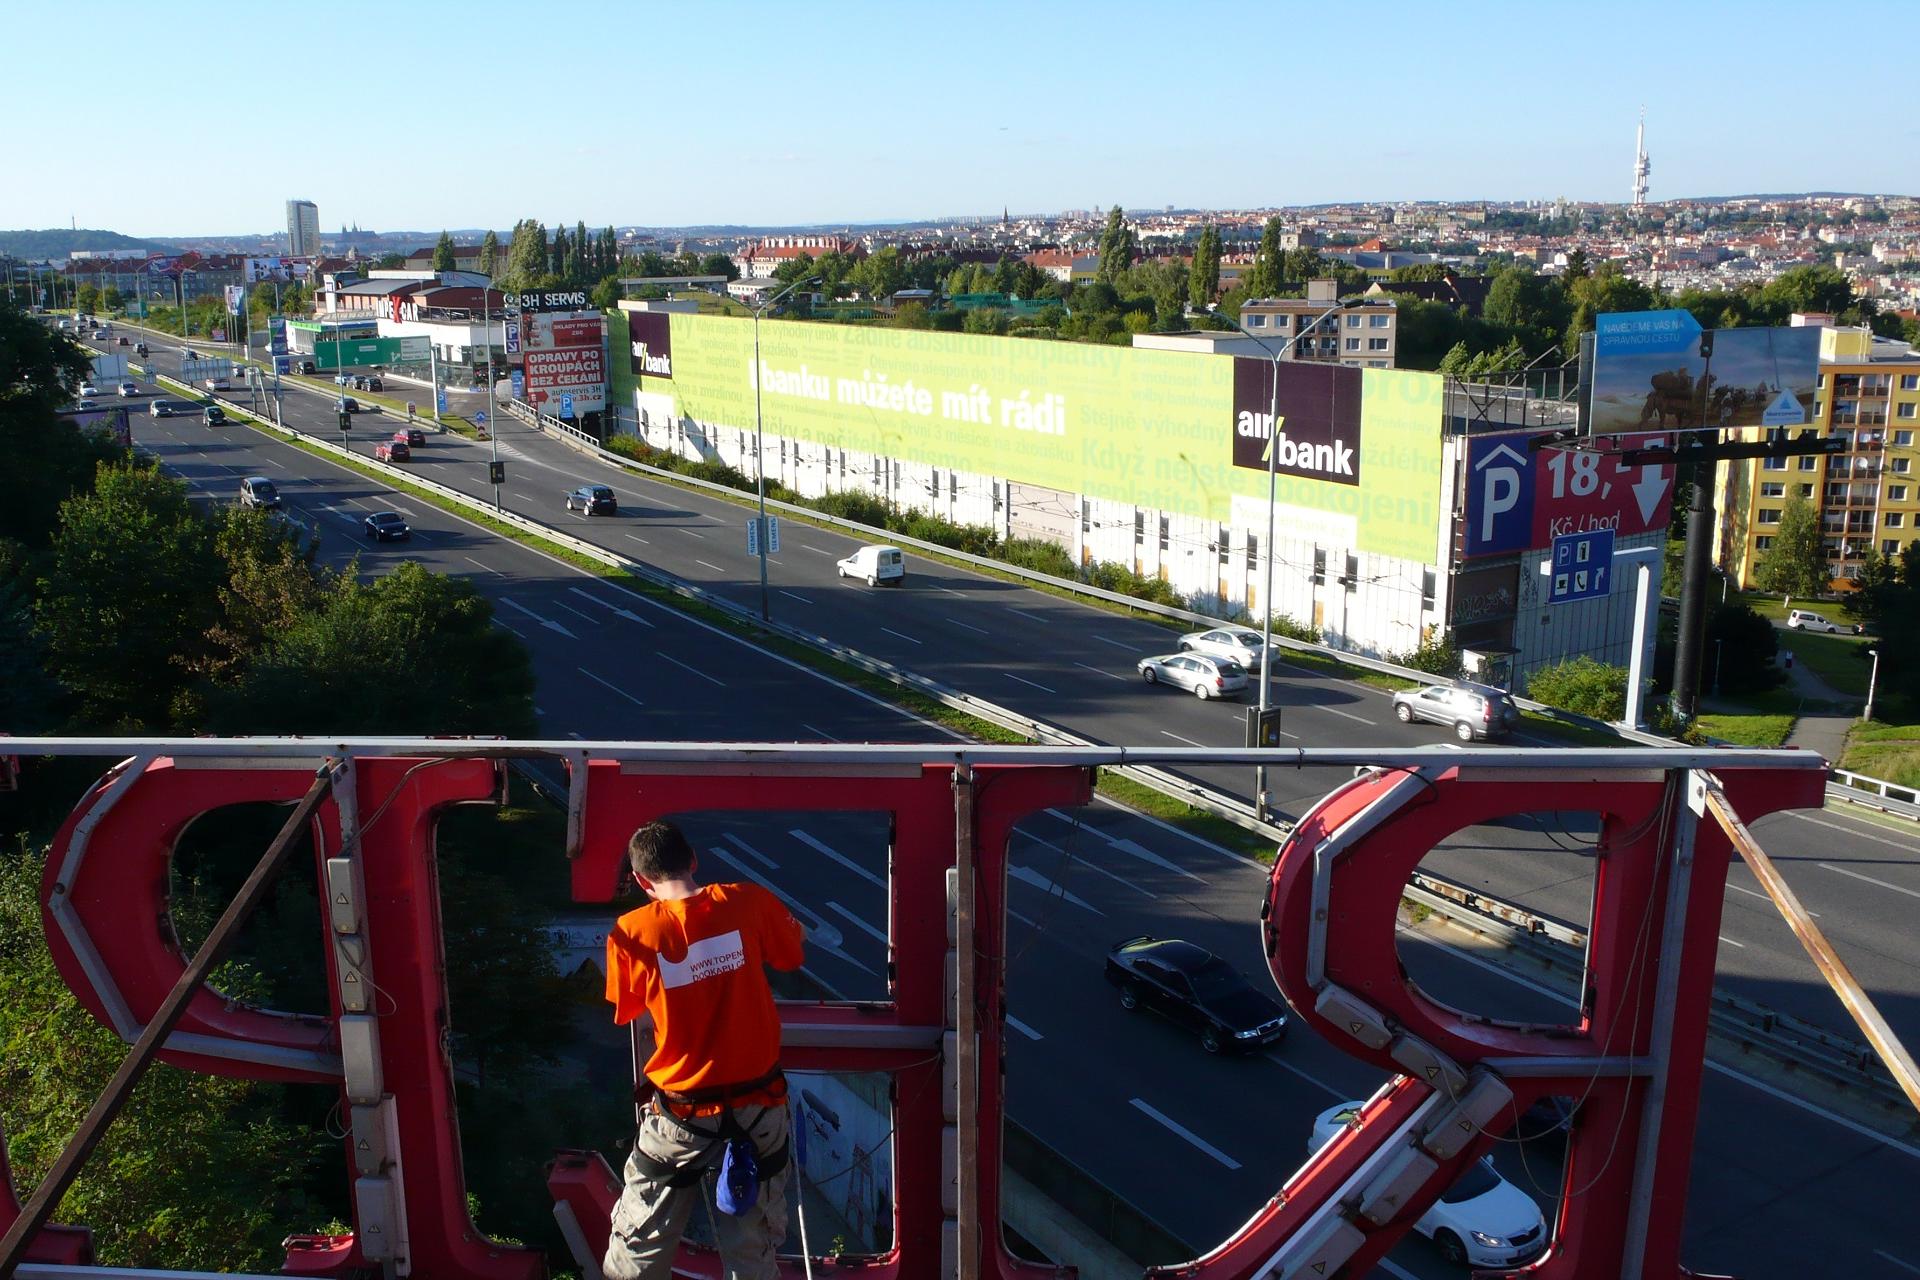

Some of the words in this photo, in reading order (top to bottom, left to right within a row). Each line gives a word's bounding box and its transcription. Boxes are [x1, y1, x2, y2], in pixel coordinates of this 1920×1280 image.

[522, 294, 540, 307] 3H
[544, 292, 586, 306] SERVIS
[528, 351, 578, 363] OPRAVY
[582, 350, 599, 360] PO
[529, 360, 600, 375] KROUPÁCH
[645, 352, 671, 375] bank
[530, 376, 554, 387] BEZ
[760, 358, 830, 401] banku
[836, 367, 933, 417] můžete
[941, 382, 992, 424] mít
[1001, 388, 1065, 437] rádi
[1278, 432, 1354, 476] bank
[1588, 509, 1622, 532] hod
[770, 517, 778, 551] SIEMENS
